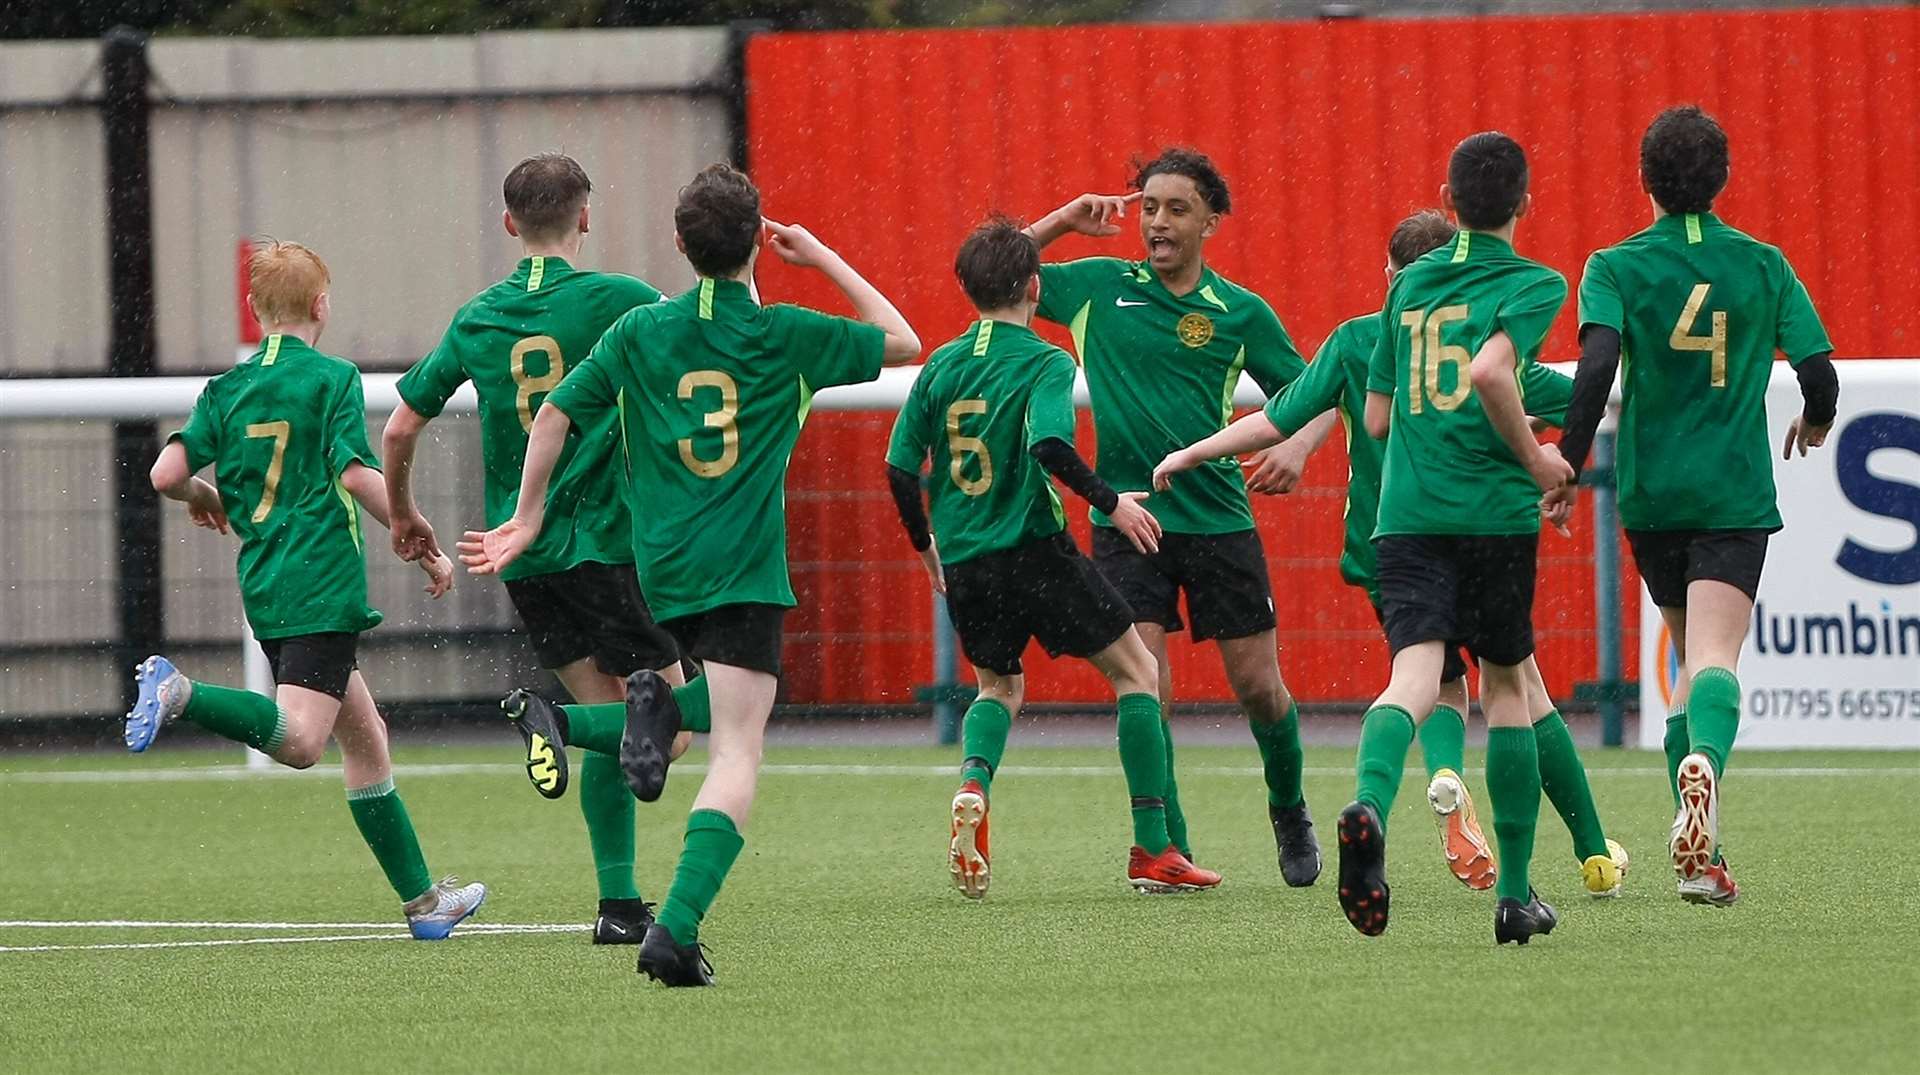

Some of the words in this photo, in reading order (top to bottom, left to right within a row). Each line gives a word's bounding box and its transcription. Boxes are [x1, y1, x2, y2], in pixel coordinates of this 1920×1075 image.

[510, 335, 563, 434] 8
[1401, 304, 1472, 415] 16
[1669, 284, 1727, 387] 4
[246, 421, 290, 523] 7
[677, 371, 740, 478] 3
[945, 399, 993, 496] 6
[1836, 412, 1920, 585] S
[1756, 602, 1920, 656] lumbin
[1750, 689, 1831, 718] 01795
